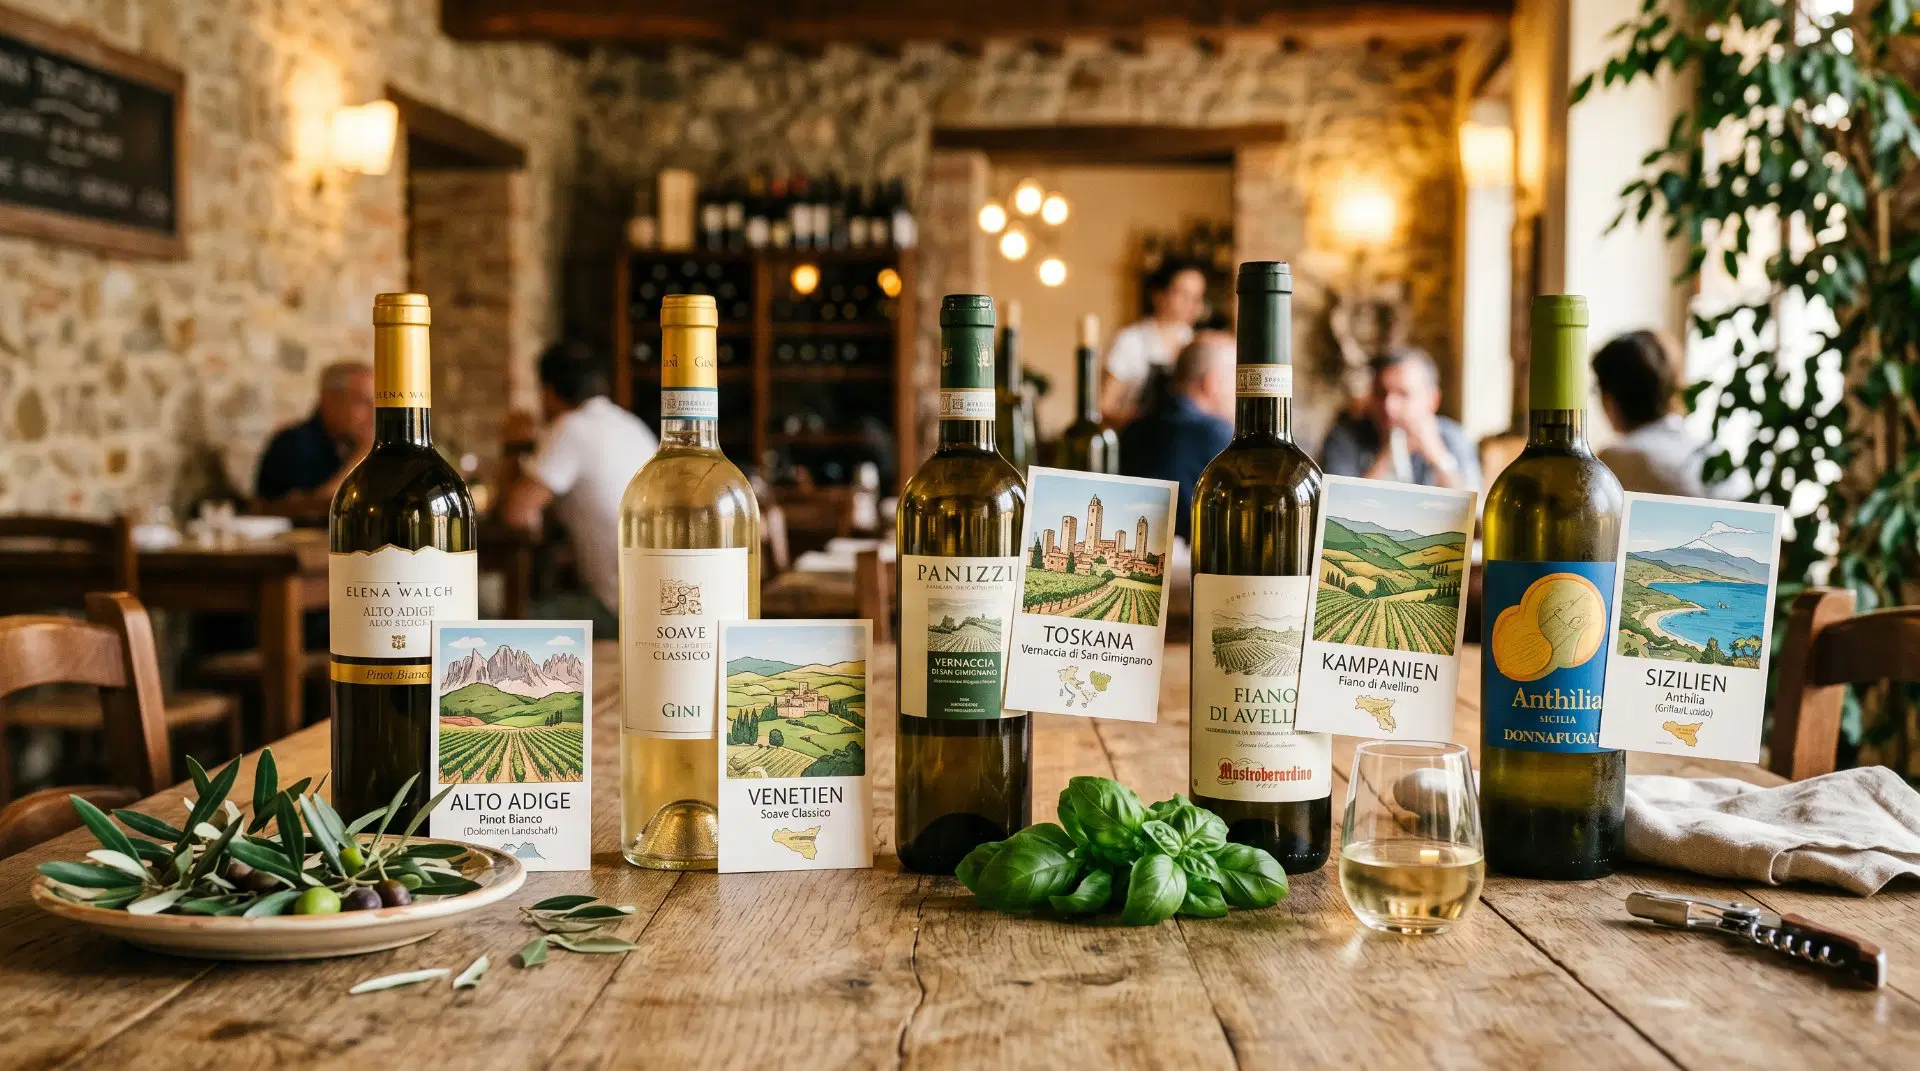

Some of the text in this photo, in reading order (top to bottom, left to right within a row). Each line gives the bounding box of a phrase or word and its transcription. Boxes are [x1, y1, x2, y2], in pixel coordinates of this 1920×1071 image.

[917, 564, 1014, 583] PANIZZI
[346, 586, 453, 598] ELENA WALCH
[363, 605, 436, 617] ALTO ADIGE
[656, 626, 706, 639] SOAVE
[1043, 625, 1134, 650] TOSKANA
[653, 651, 710, 661] CLASSICO
[1021, 644, 1153, 666] Vernaccia di San Gimignano
[934, 657, 994, 668] VERNACCIA
[1322, 652, 1439, 682] KAMPANIEN
[366, 669, 432, 680] Pinot Bianco
[939, 668, 954, 676] SAN
[1338, 676, 1419, 694] Fiano di Avellino
[1645, 668, 1727, 693] SIZILIEN
[1233, 687, 1298, 704] FIANO
[1209, 706, 1228, 722] DI
[1539, 715, 1577, 724] SICILIA
[450, 792, 571, 811] ALTO ADIGE
[748, 786, 843, 806] VENETIEN
[479, 813, 543, 825] Pinot Bianco
[761, 807, 831, 819] Soave Classico
[463, 826, 558, 836] (Dolomiten Landschaft)
